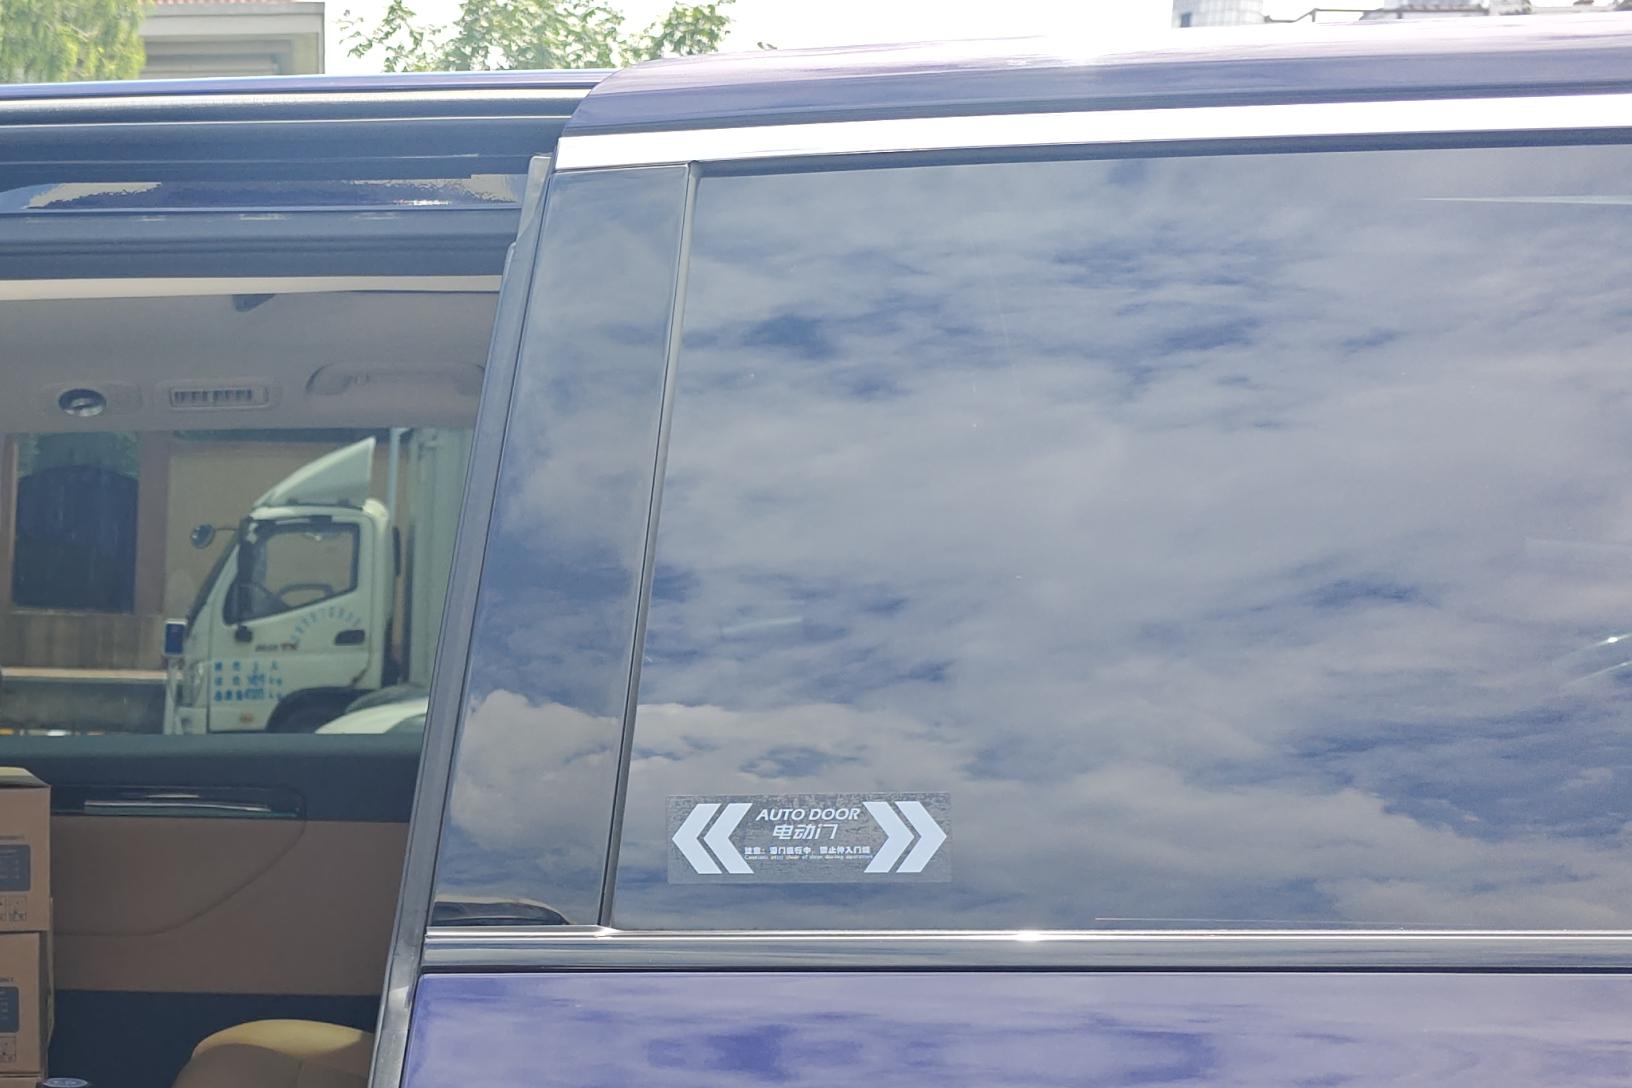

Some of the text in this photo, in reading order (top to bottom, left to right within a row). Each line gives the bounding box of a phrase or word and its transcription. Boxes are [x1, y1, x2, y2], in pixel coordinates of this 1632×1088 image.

[755, 807, 861, 821] AUTO DOOR
[772, 823, 839, 841] 电动门
